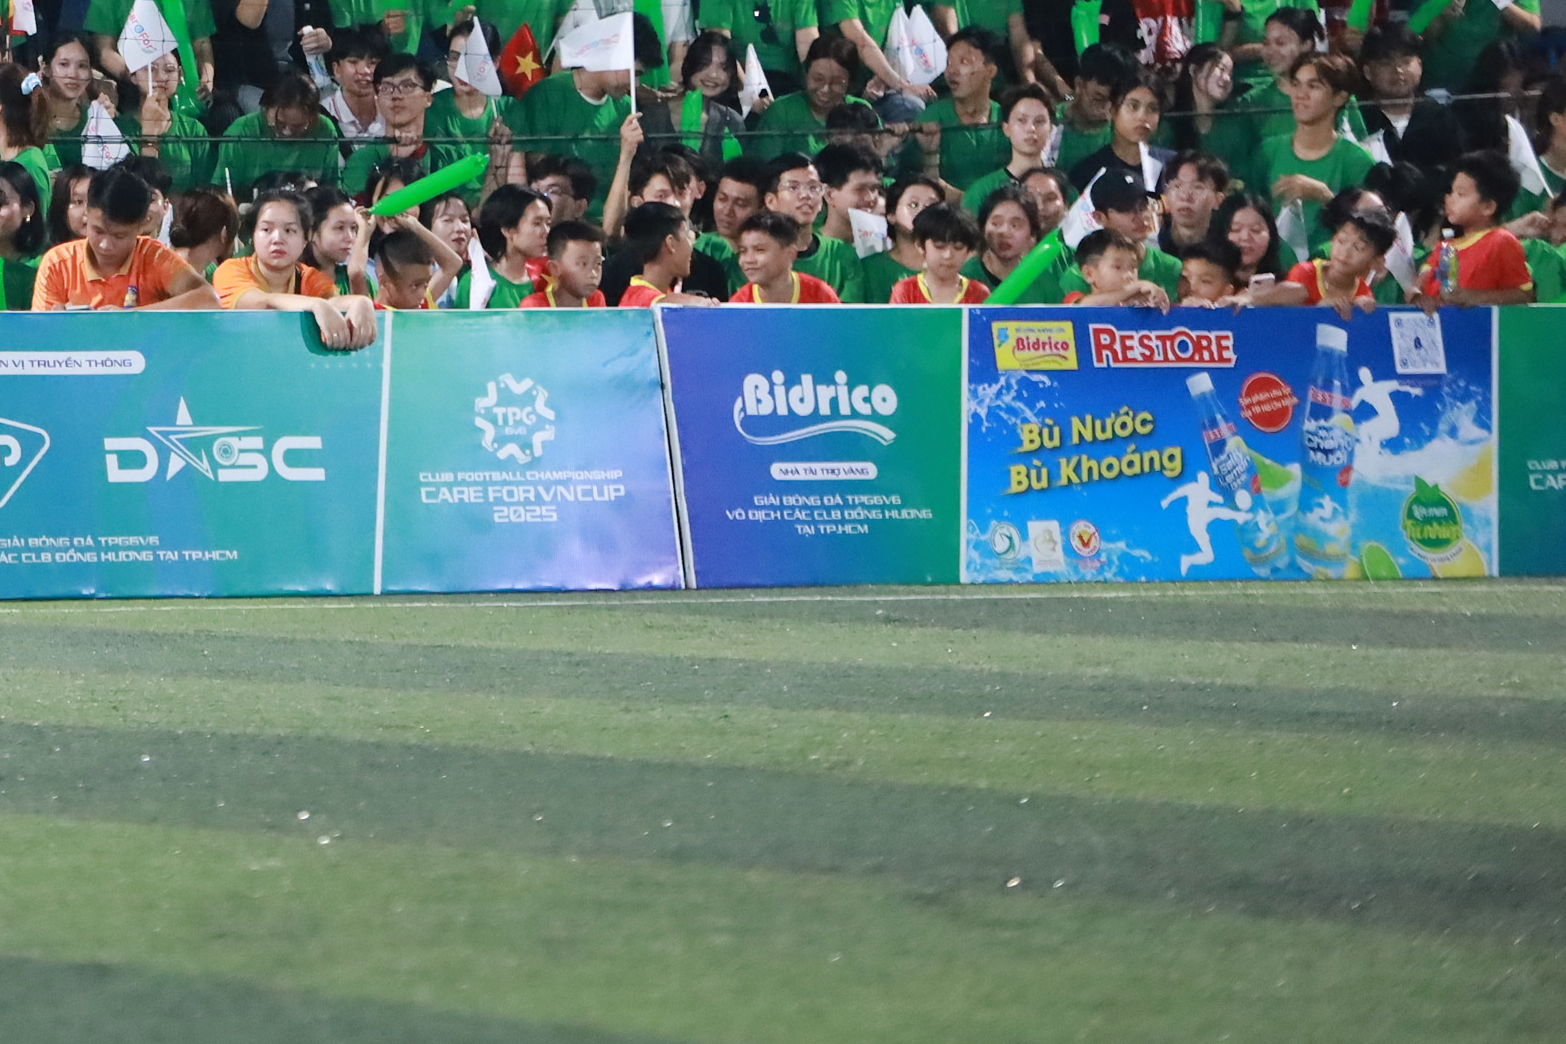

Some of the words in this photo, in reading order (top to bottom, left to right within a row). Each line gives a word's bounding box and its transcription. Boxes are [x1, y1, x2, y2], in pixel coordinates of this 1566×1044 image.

[1016, 336, 1069, 351] Bidrico
[1091, 326, 1234, 365] RESTORE
[11, 359, 25, 370] VỊ
[85, 357, 133, 368] THÔNG
[742, 369, 898, 417] Bidrico
[492, 406, 537, 426] TPG
[1014, 418, 1061, 452] Bù
[1070, 405, 1154, 445] Nước
[419, 472, 454, 483] CLUB
[457, 471, 525, 482] FOOTBALL
[526, 470, 623, 481] CHAMPIONSHIP
[1005, 459, 1048, 495] Bù
[1056, 444, 1182, 486] Khoáng
[420, 486, 484, 504] CARE
[487, 485, 535, 503] FOR
[536, 485, 575, 502] VN
[576, 484, 626, 502] CUP
[492, 505, 558, 523] 2025
[783, 508, 812, 520] CÁC
[814, 509, 842, 520] CLB
[818, 523, 869, 534] TP.HCM
[21, 552, 52, 563] CLB
[156, 550, 179, 564] TẠI
[182, 550, 238, 561] TP.HCM
